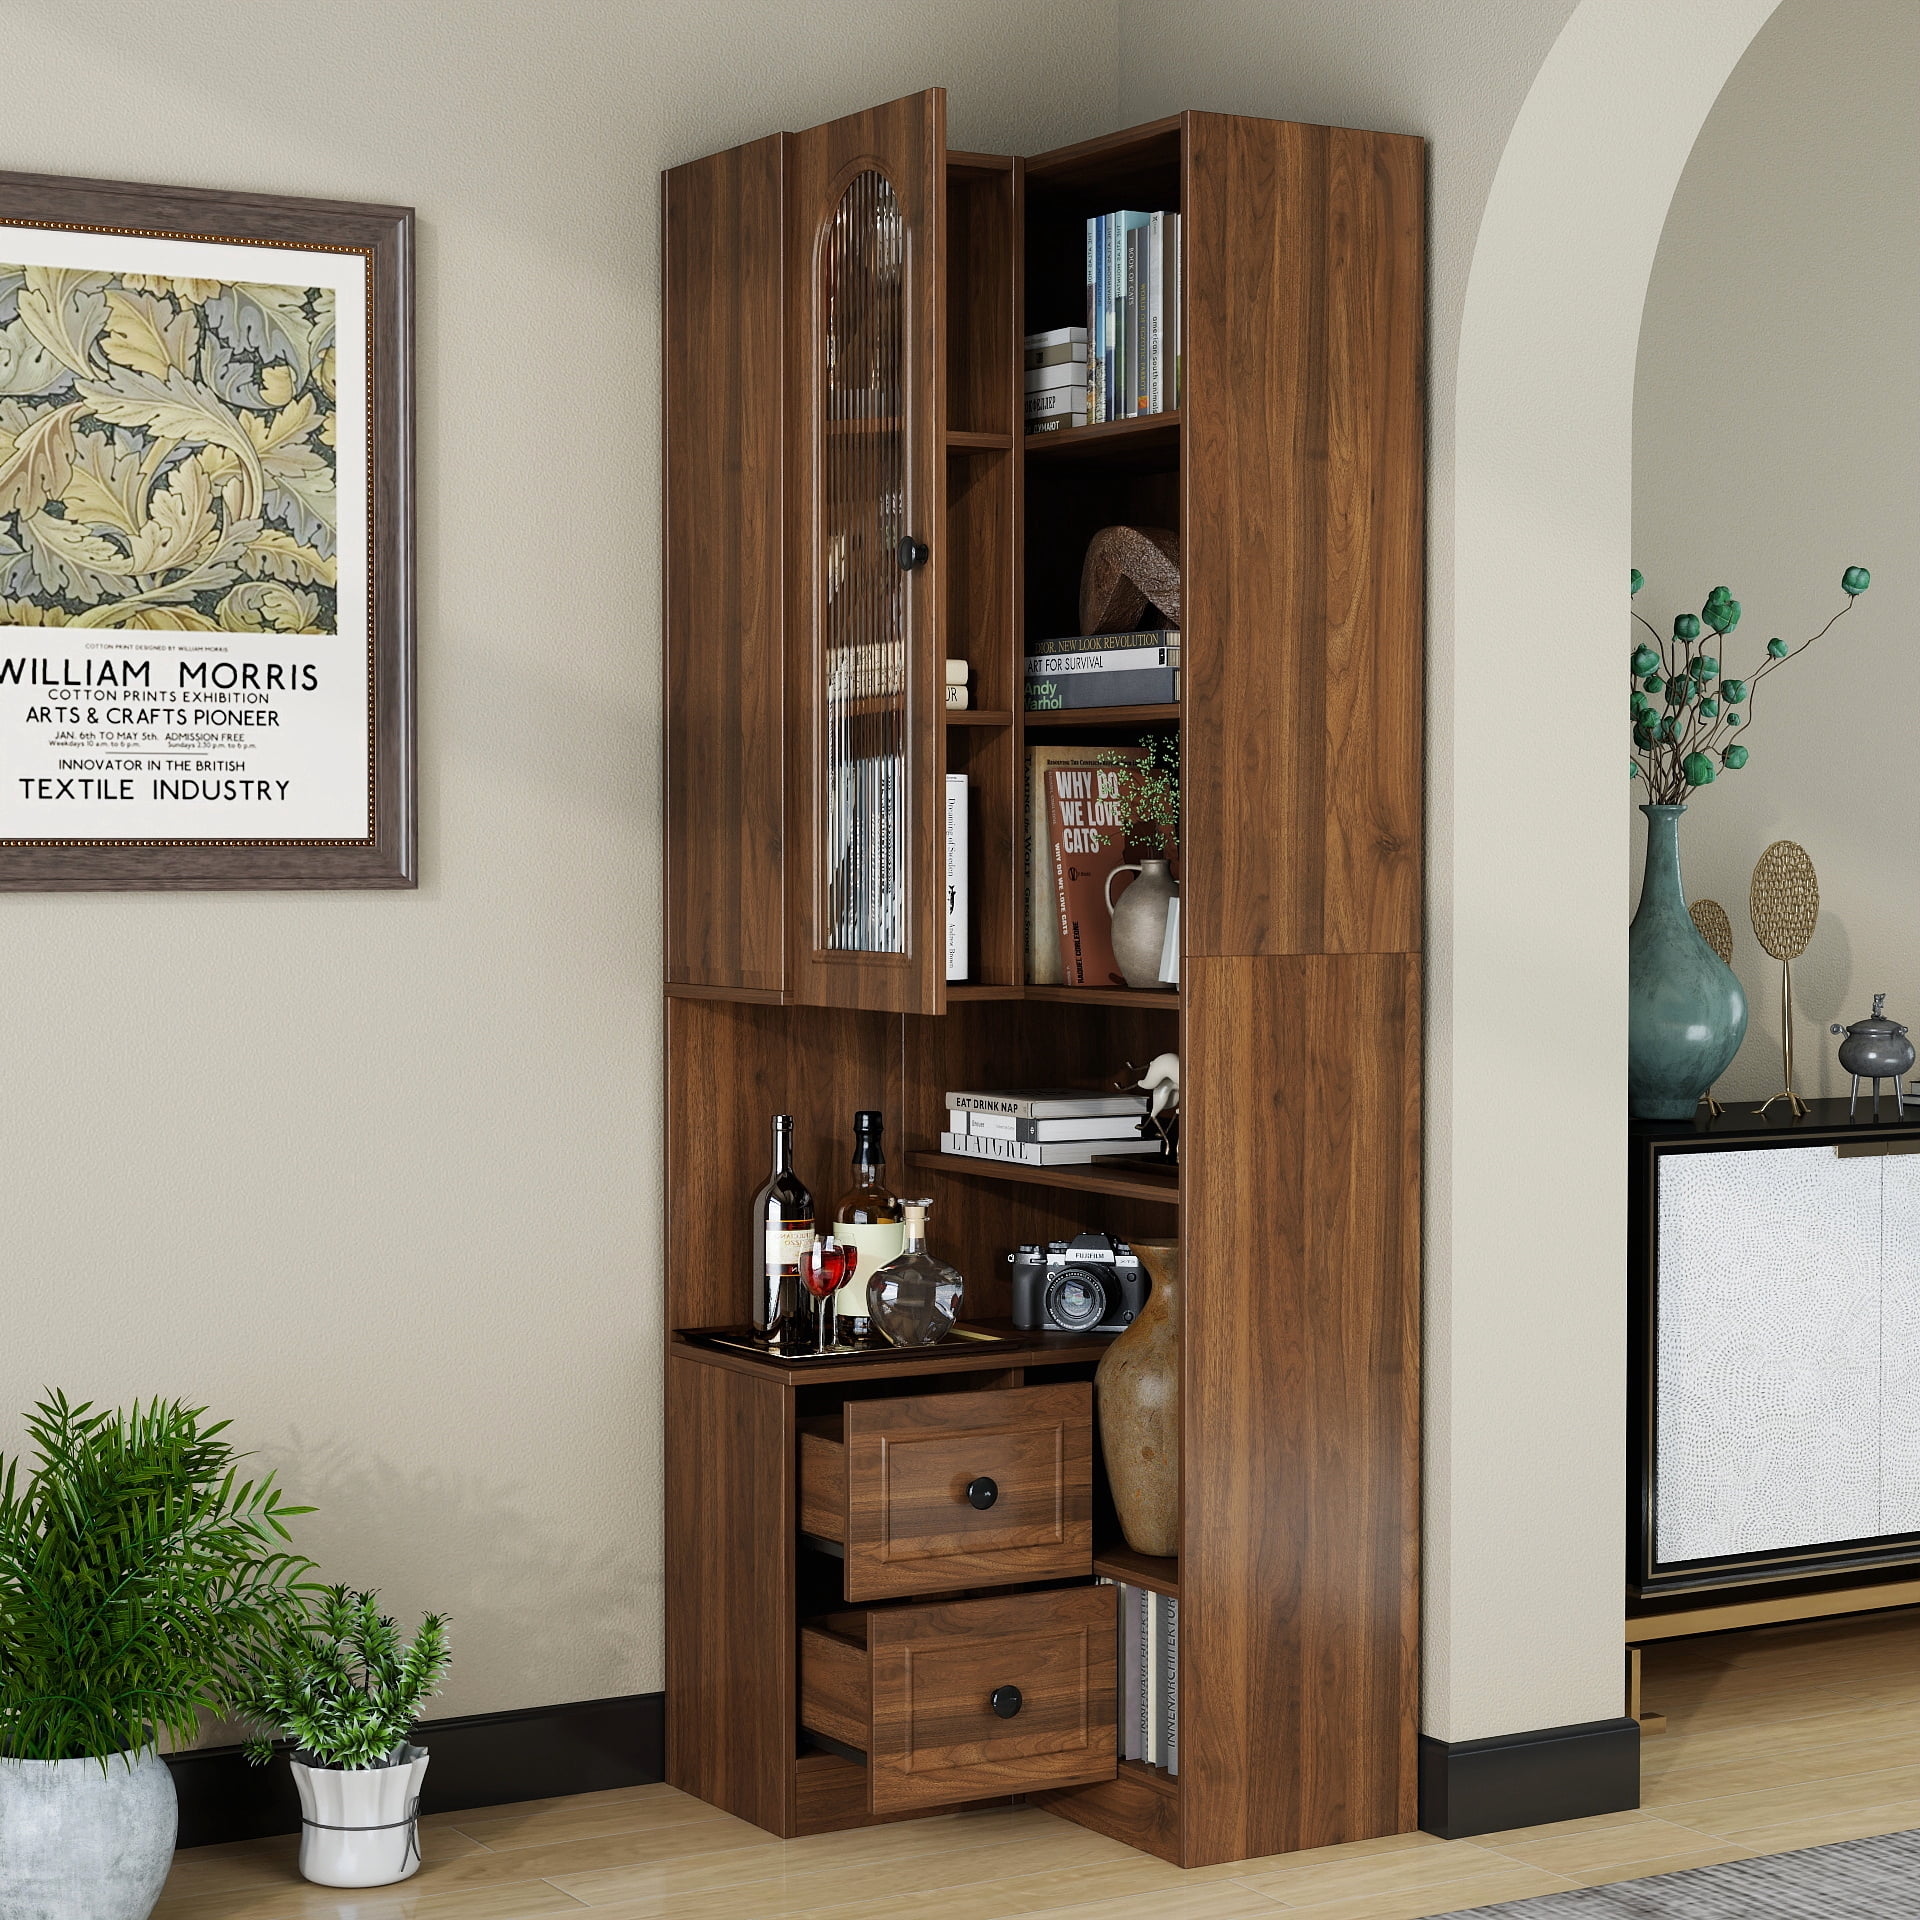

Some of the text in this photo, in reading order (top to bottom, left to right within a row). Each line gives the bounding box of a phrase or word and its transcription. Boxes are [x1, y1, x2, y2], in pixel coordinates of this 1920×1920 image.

[1058, 639, 1077, 652] NEW
[1079, 638, 1102, 650] LOOK
[1103, 633, 1159, 649] REVOLUTION
[1028, 656, 1103, 673] ART FOR SURVIVAL
[0, 658, 318, 691] WILLIAM MORRIS
[48, 688, 269, 704] COTTON PRINTS EXHIBITION
[26, 706, 280, 726] ARTS & CRAFTS PIONEER
[48, 740, 84, 748] Weekdays
[80, 732, 96, 740] 6th
[100, 732, 114, 740] TO
[117, 732, 138, 740] MAY
[165, 732, 218, 741] ADMISSION
[222, 733, 245, 742] FREE
[58, 758, 245, 772] INNOVATOR IN THE BRITISH
[19, 778, 290, 801] TEXTILE INDUSTRY
[1056, 772, 1119, 800] WHY DO
[946, 798, 956, 836] Dreaming
[1060, 800, 1124, 826] WE LOVE
[1063, 828, 1100, 854] CATS
[947, 846, 956, 877] Sweden
[1058, 877, 1064, 890] WE
[956, 1098, 1018, 1114] EAT DRINK NAP
